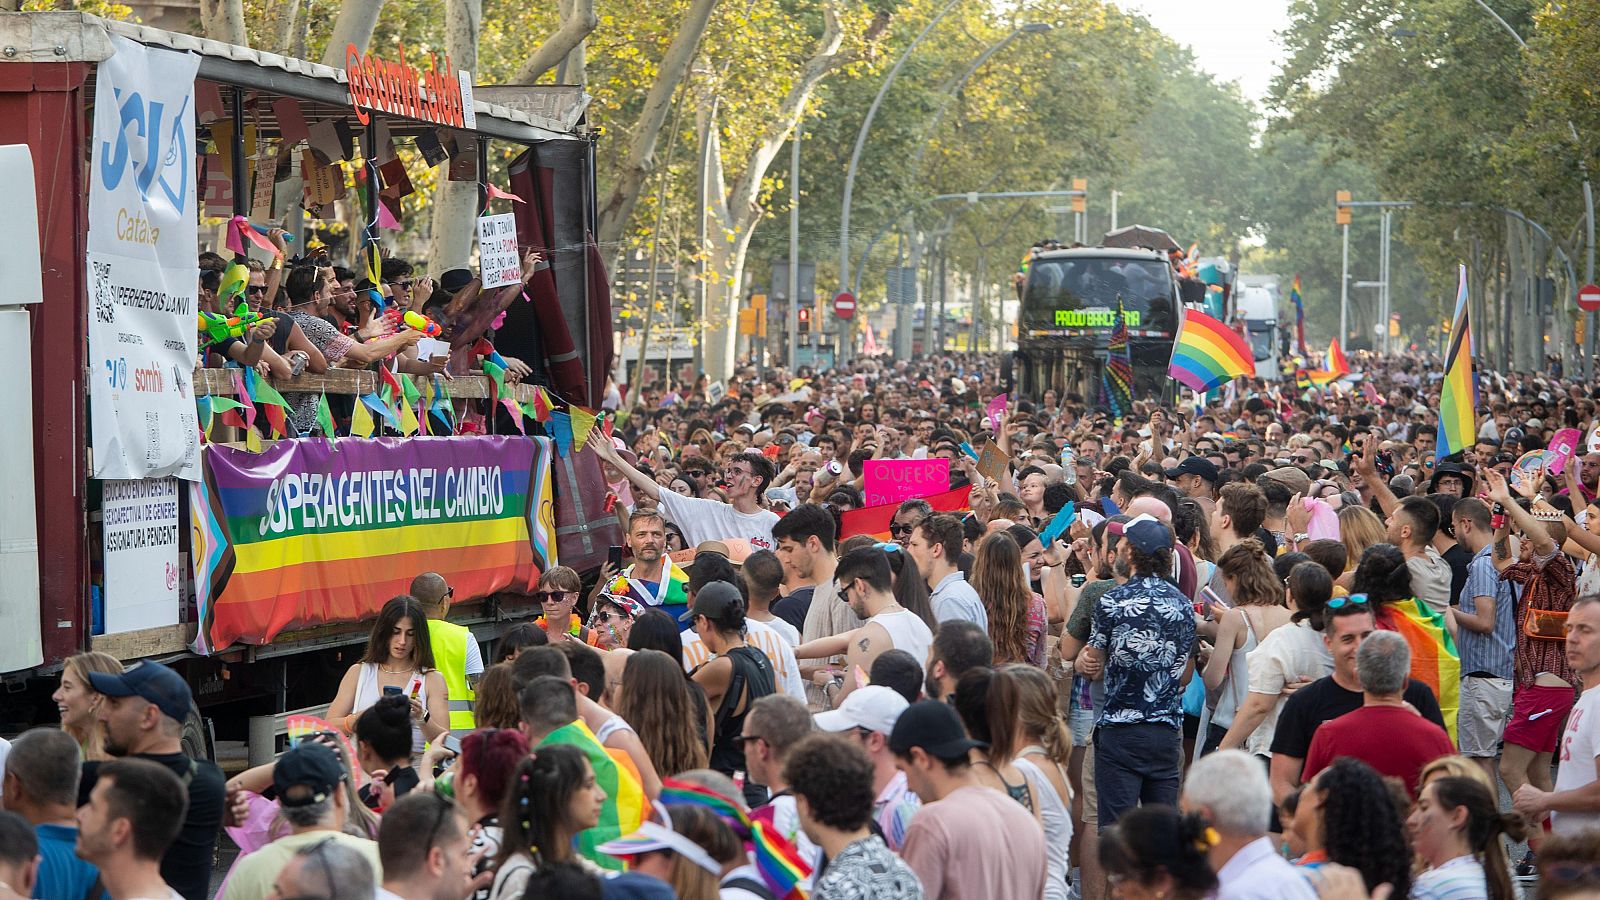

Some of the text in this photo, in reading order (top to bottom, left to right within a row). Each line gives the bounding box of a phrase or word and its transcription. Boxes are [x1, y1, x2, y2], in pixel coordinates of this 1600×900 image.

[346, 42, 463, 128] @somhi.club
[484, 258, 495, 270] QUE
[497, 257, 505, 268] NO
[110, 285, 166, 311] SUPERHEROIS
[1055, 310, 1140, 326] PROUD BARCENA
[874, 463, 947, 484] QUEERS
[132, 481, 140, 499] EN
[259, 465, 504, 536] SUPERAGENTES DEL CAMBIO
[145, 503, 152, 521] DE
[106, 525, 177, 553] ASSIGNATURA PENDENT
